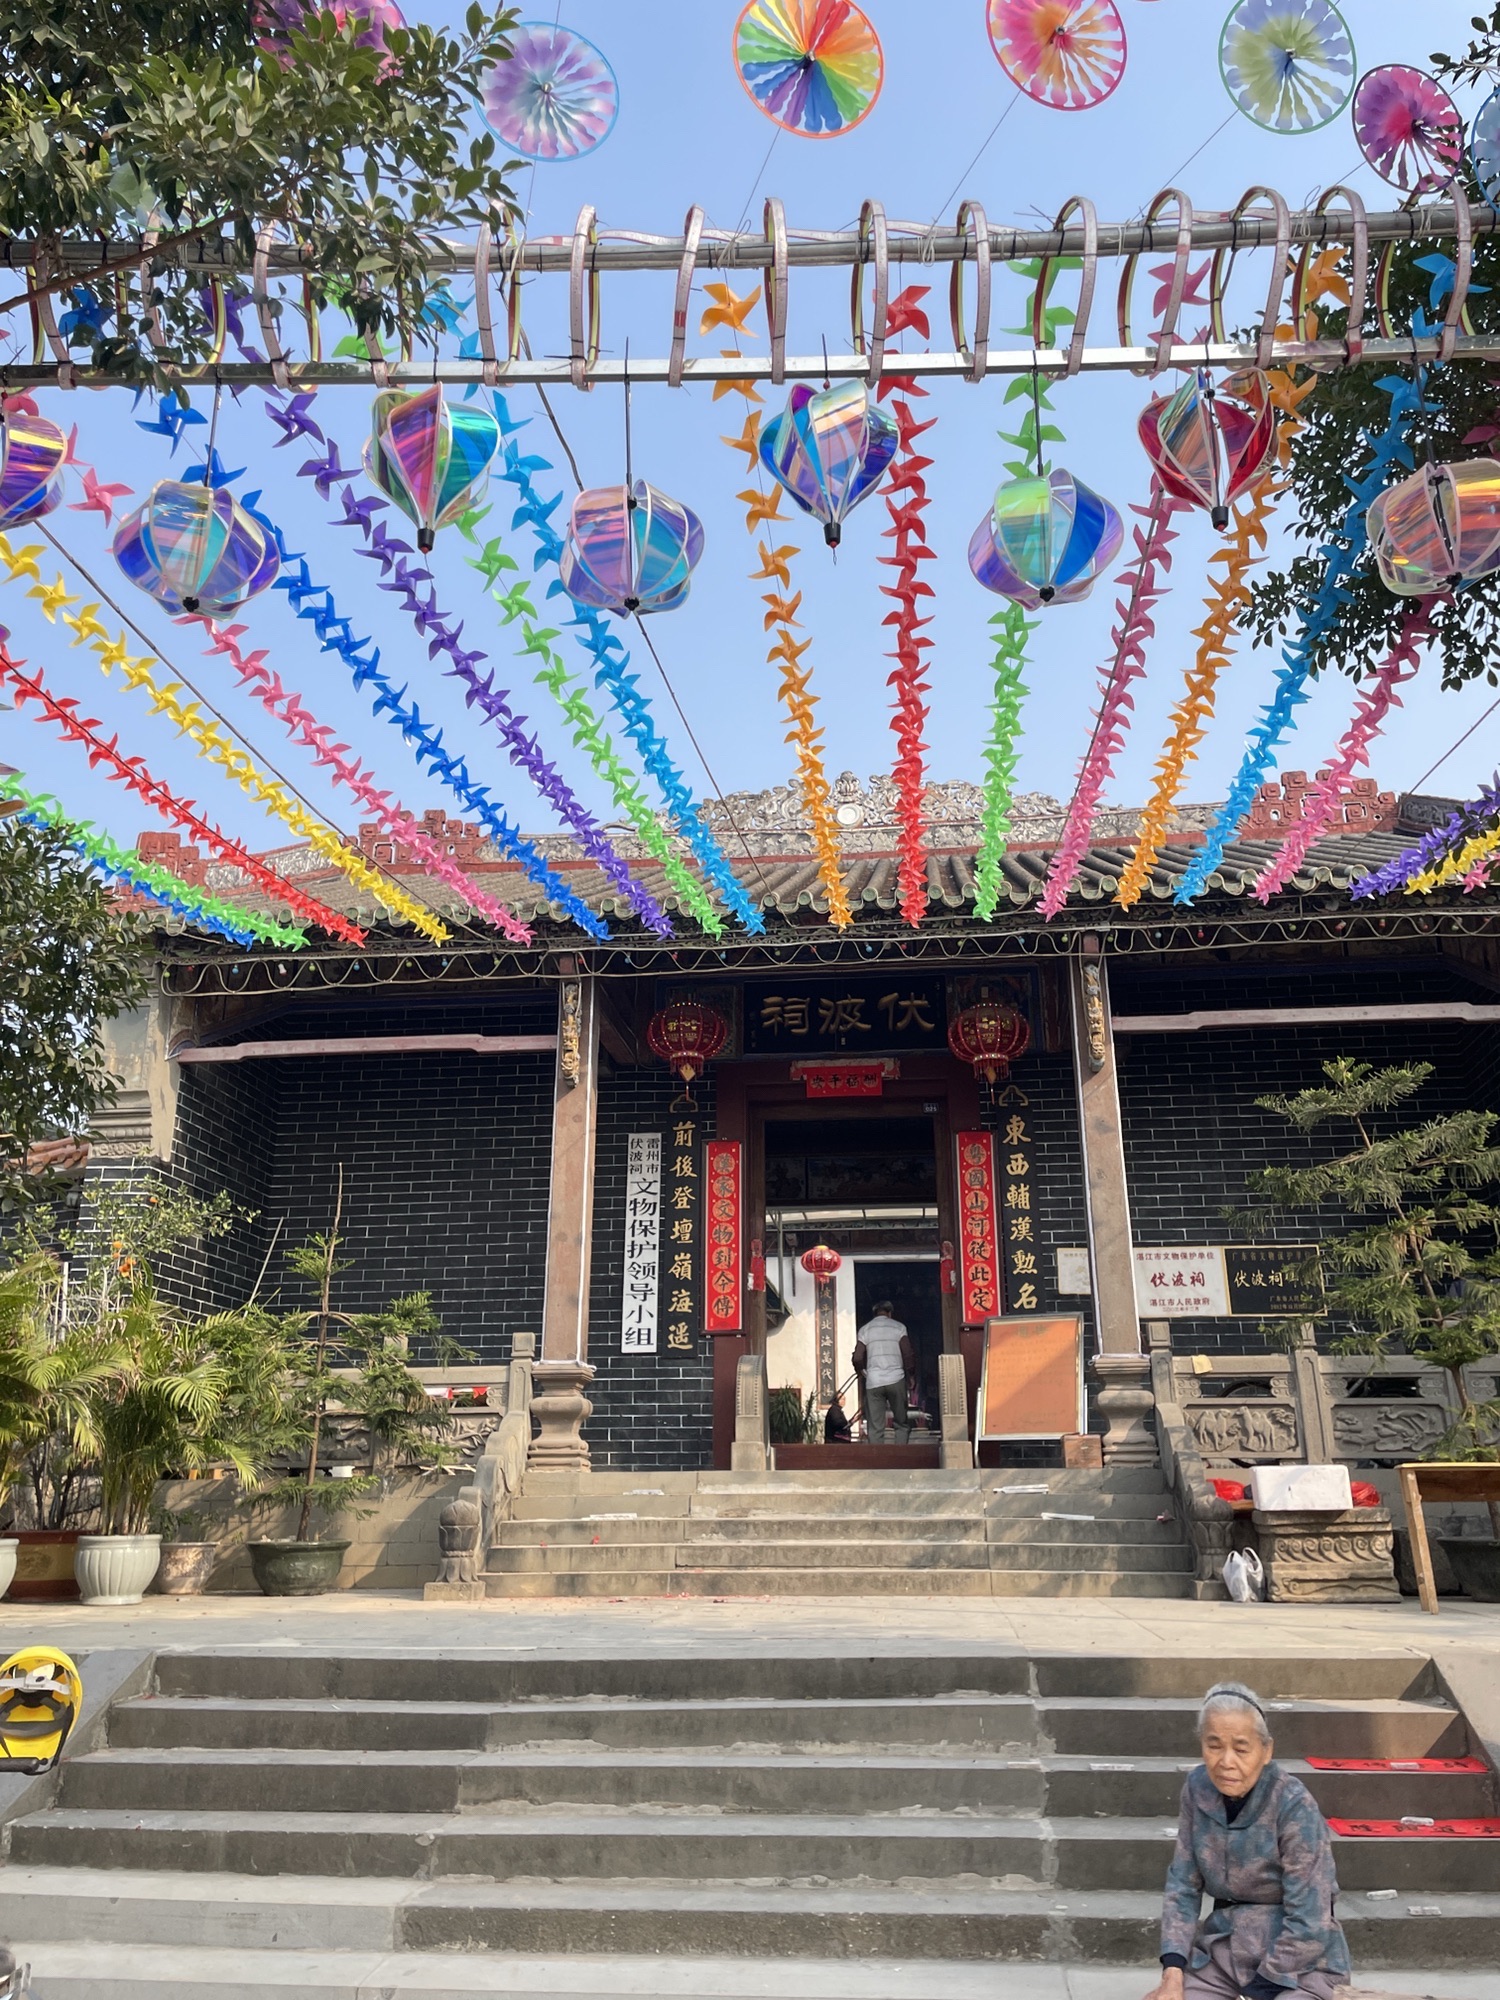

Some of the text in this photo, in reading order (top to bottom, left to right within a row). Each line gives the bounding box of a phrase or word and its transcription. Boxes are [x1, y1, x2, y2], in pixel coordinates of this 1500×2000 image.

[760, 992, 936, 1037] 伏波祠
[629, 1137, 643, 1175] 伏波祠
[646, 1138, 660, 1175] 雷州市
[624, 1177, 659, 1347] 文物保护领导小组
[1136, 1252, 1215, 1261] 湛江市文物保护单位
[1150, 1270, 1206, 1288] 伏波祠
[1149, 1297, 1210, 1307] 湛江市人民政府
